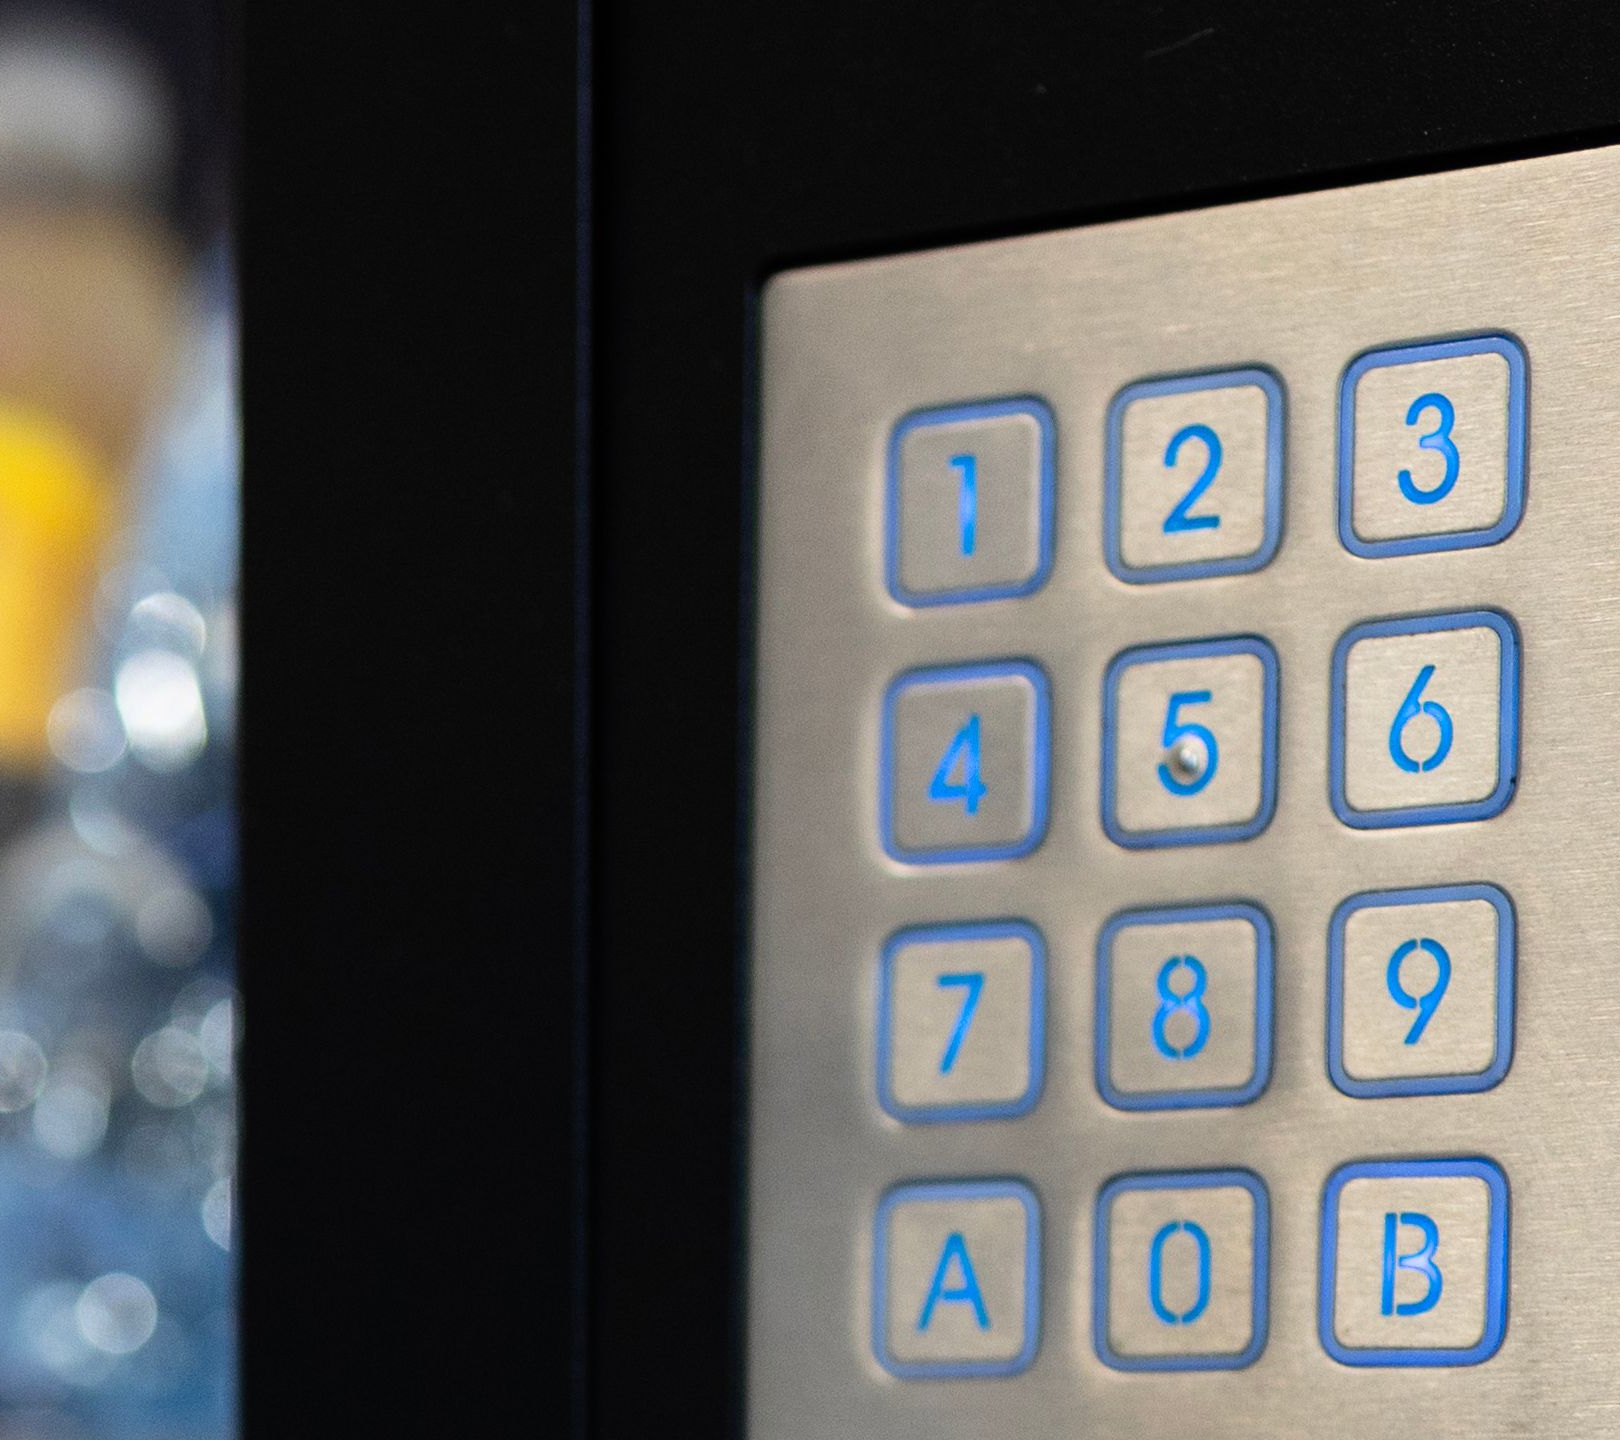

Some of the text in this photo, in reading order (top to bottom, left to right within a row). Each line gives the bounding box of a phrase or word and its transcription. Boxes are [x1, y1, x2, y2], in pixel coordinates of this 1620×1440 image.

[947, 392, 1461, 558] 1 2 3
[927, 664, 1454, 817] 4 5 6
[934, 937, 1452, 1076] 7 8 9
[916, 1231, 991, 1333] A
[1380, 1210, 1444, 1318] B
